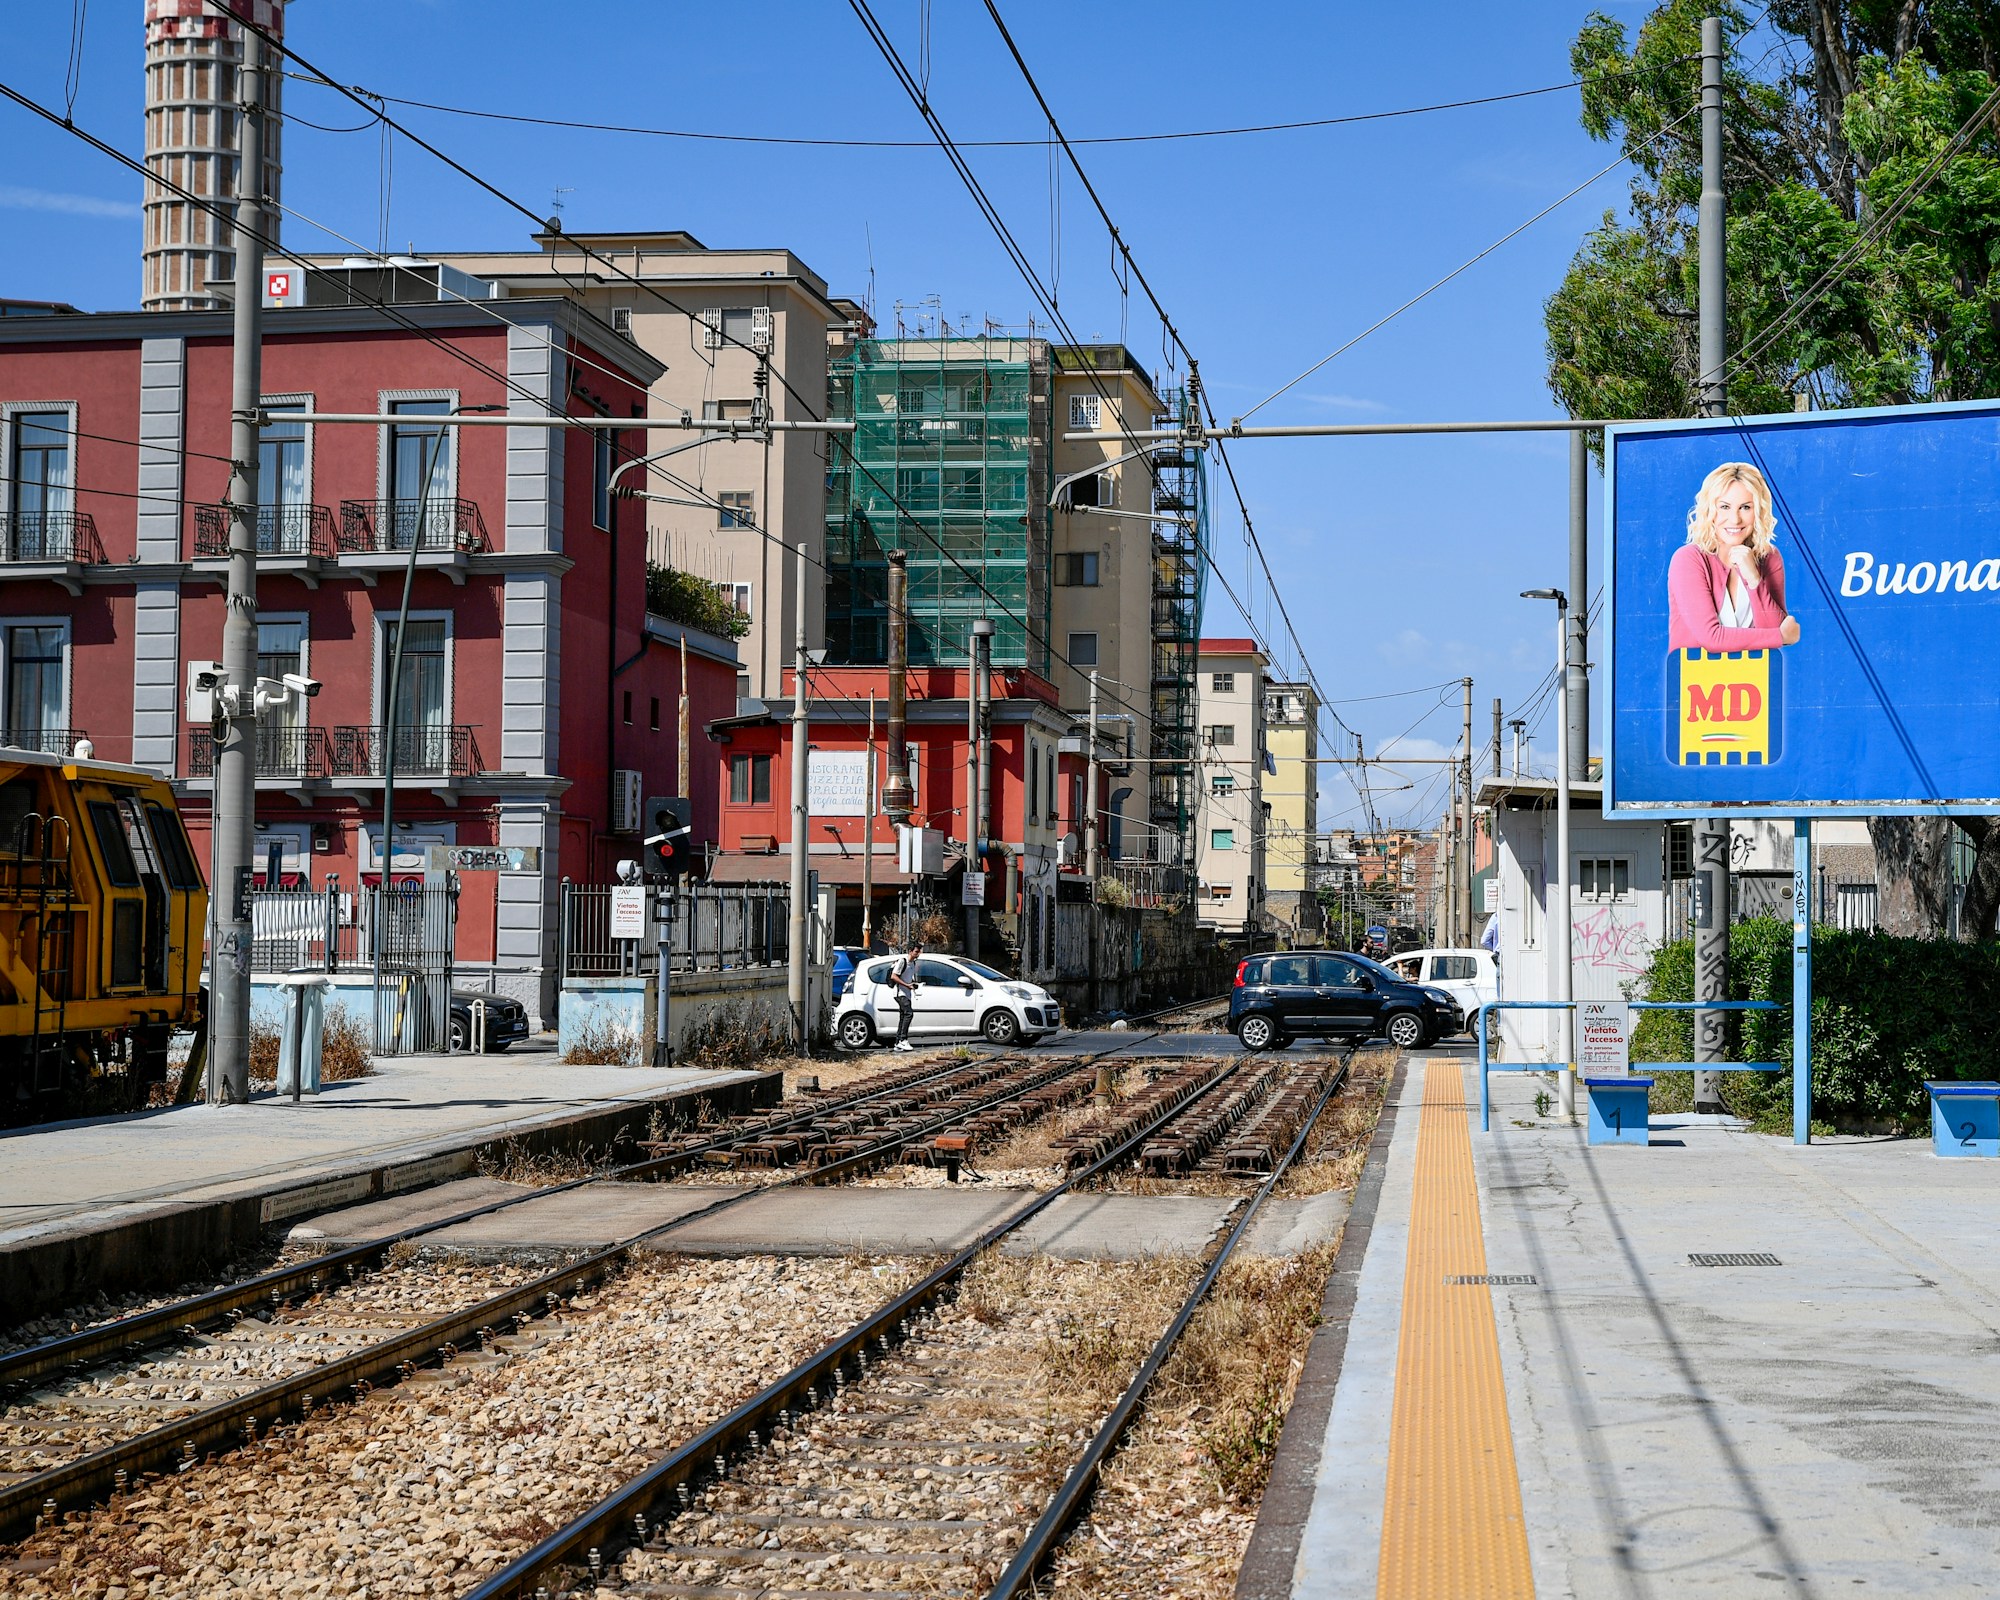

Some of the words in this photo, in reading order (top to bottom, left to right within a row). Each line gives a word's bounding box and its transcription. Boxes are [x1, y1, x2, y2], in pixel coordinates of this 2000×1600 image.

[1686, 683, 1762, 723] MD
[809, 765, 864, 774] ISTORANTE
[398, 836, 418, 845] Bar
[1243, 922, 1258, 933] 60
[1584, 1025, 1618, 1034] Vietato
[1584, 1034, 1624, 1043] l'accesso
[1609, 1106, 1621, 1137] 1
[1960, 1121, 1977, 1148] 2
